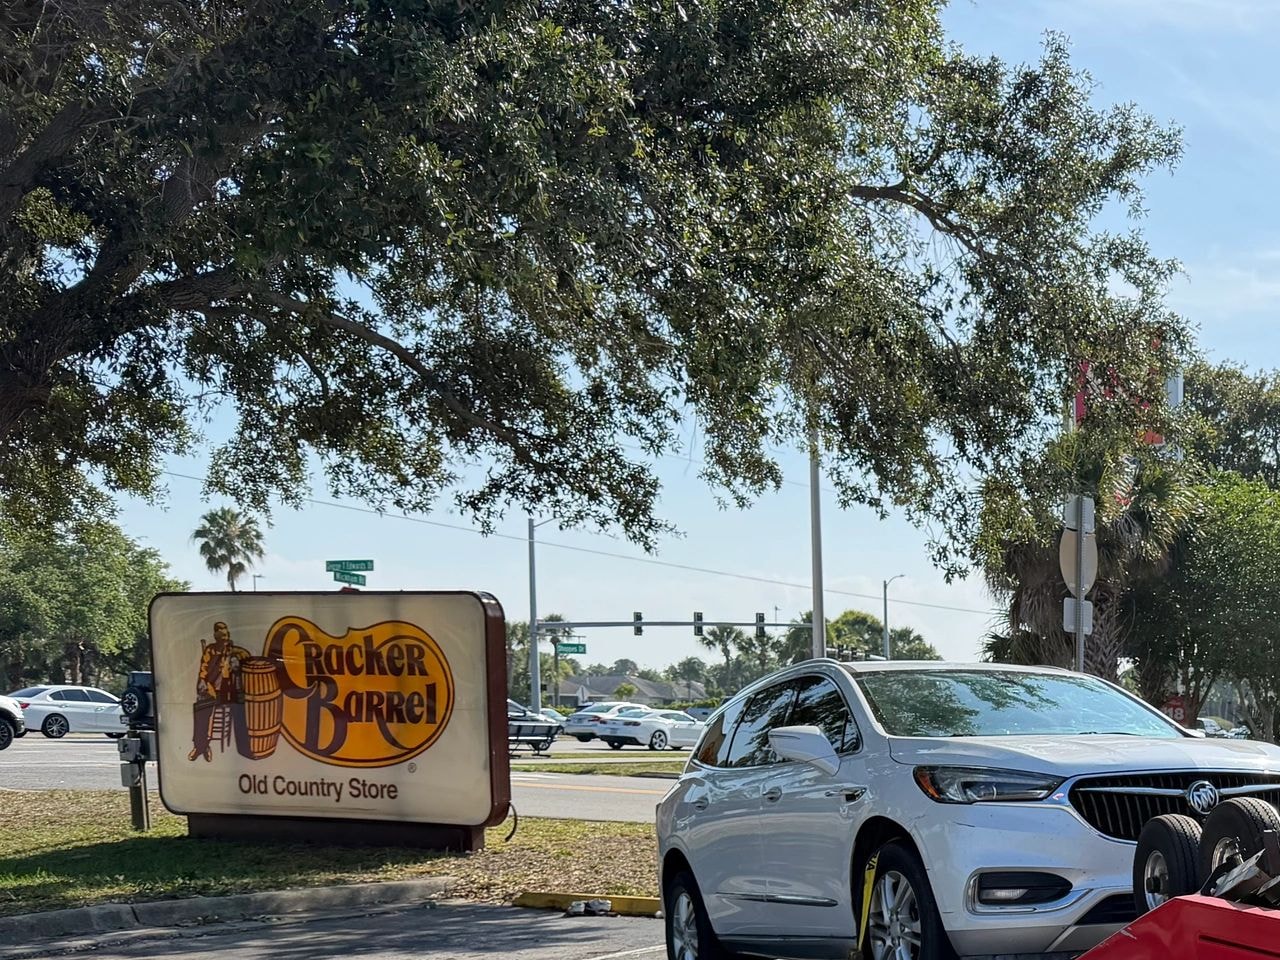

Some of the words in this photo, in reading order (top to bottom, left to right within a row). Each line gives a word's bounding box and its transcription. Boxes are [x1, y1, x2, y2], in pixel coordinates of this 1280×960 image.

[239, 774, 267, 794] Old
[273, 775, 343, 803] Country
[349, 778, 398, 800] Store
